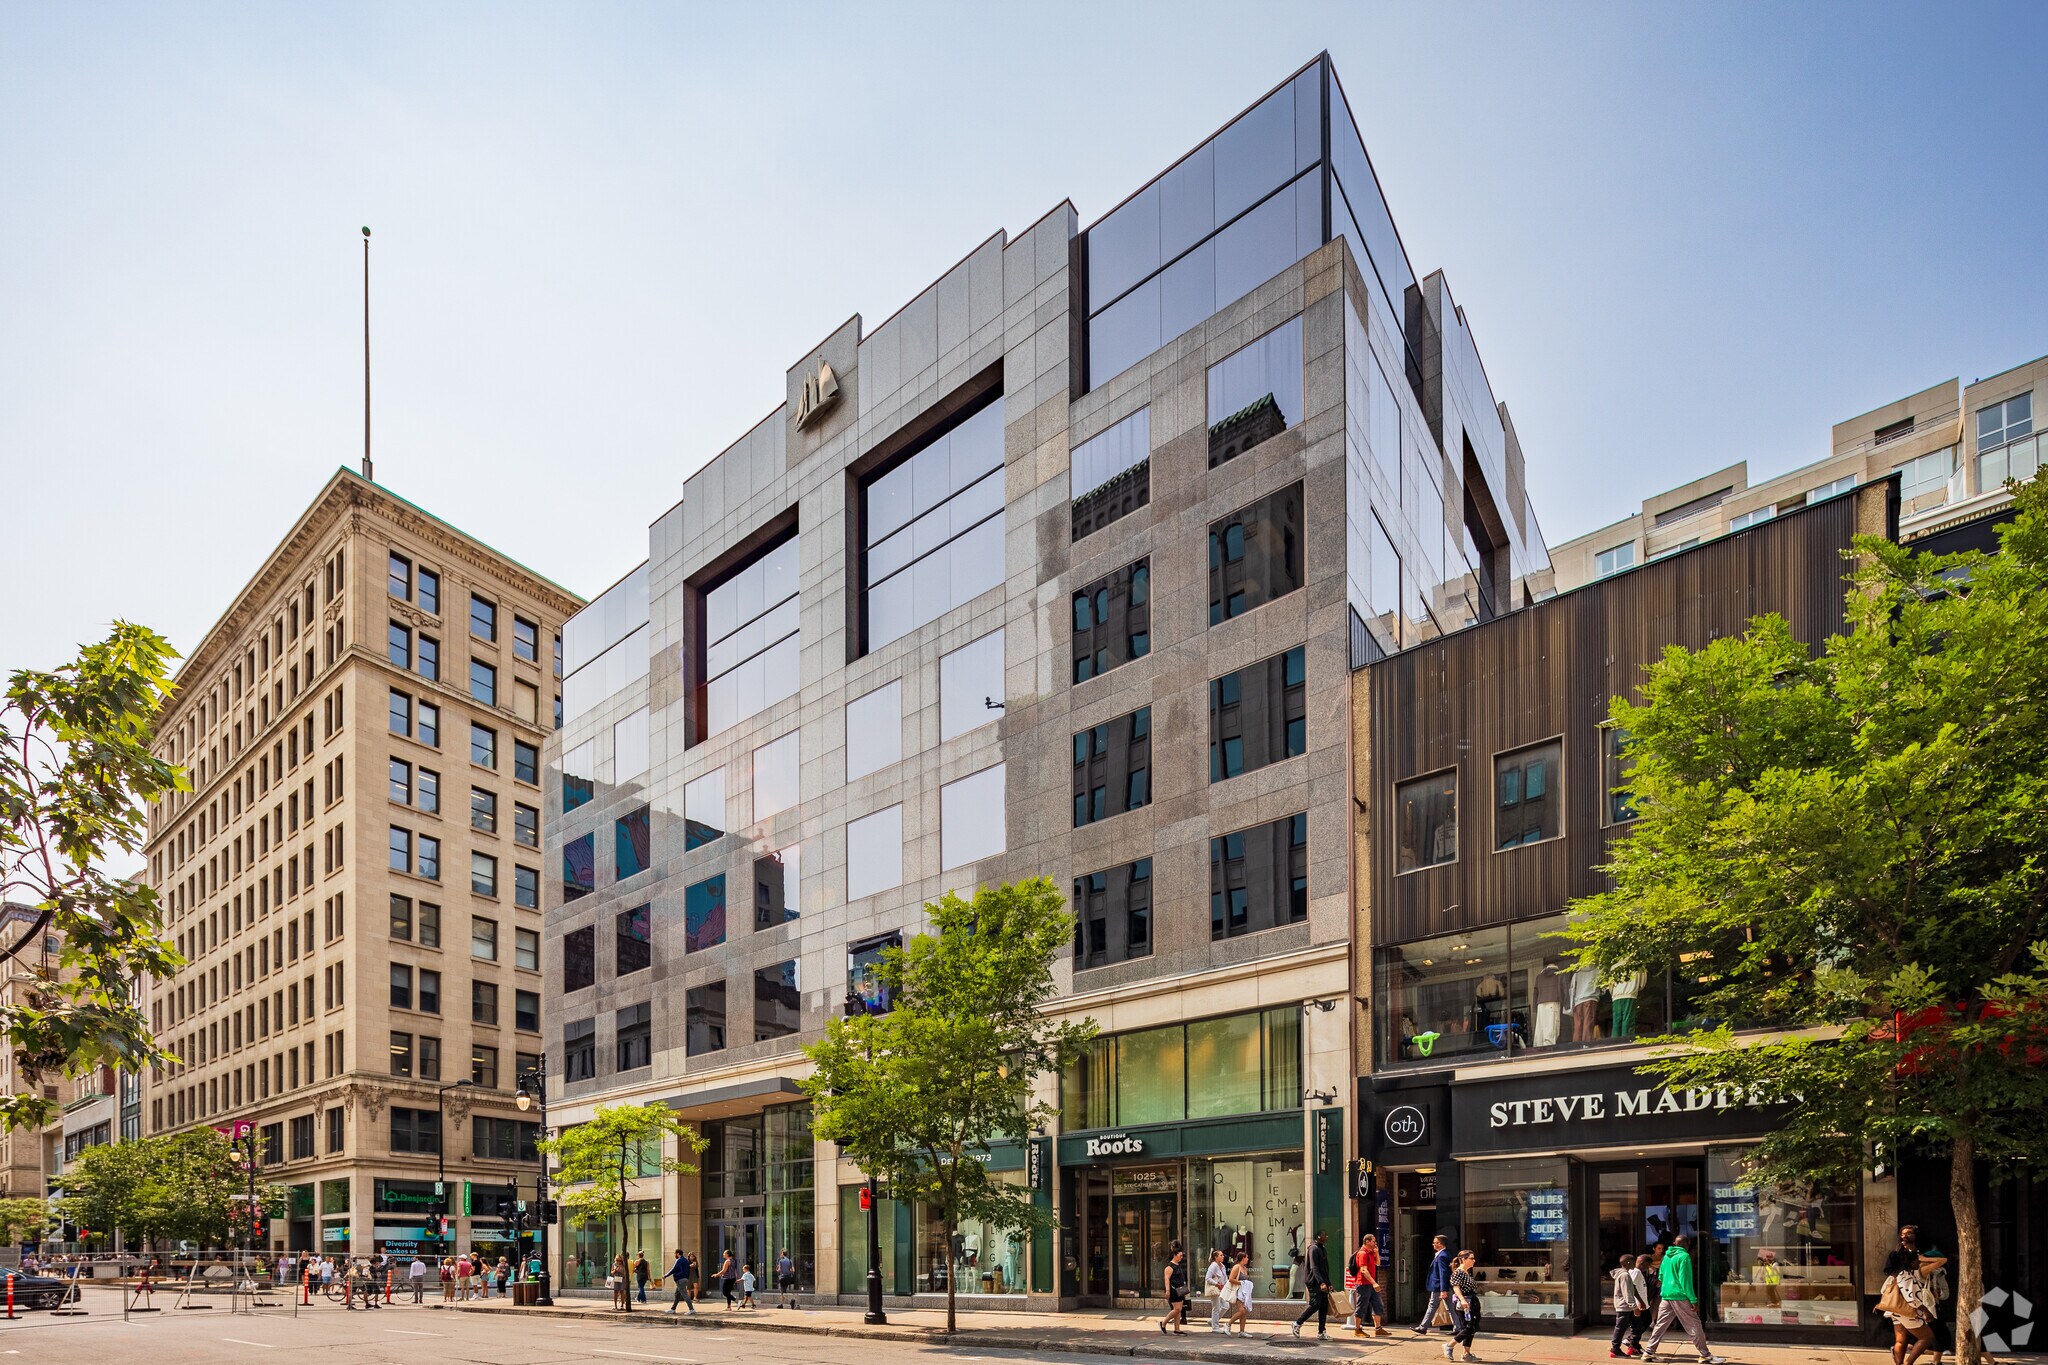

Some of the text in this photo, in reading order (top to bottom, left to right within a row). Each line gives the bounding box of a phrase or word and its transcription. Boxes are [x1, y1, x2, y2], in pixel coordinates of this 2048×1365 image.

[1490, 1093, 1606, 1128] STEVE
[1390, 1114, 1418, 1133] oth
[1086, 1137, 1143, 1157] Roots
[1031, 1142, 1040, 1188] Roots
[1133, 1172, 1156, 1181] 1025
[400, 1193, 441, 1203] Desjardin
[1715, 1187, 1754, 1199] SOLDES
[1531, 1195, 1563, 1205] SOLDES
[1531, 1209, 1563, 1219] SOLDES
[1715, 1202, 1754, 1214] SOLDES
[1531, 1223, 1563, 1234] SOLDES
[1715, 1218, 1755, 1230] SOLDES
[385, 1240, 418, 1248] Diversity
